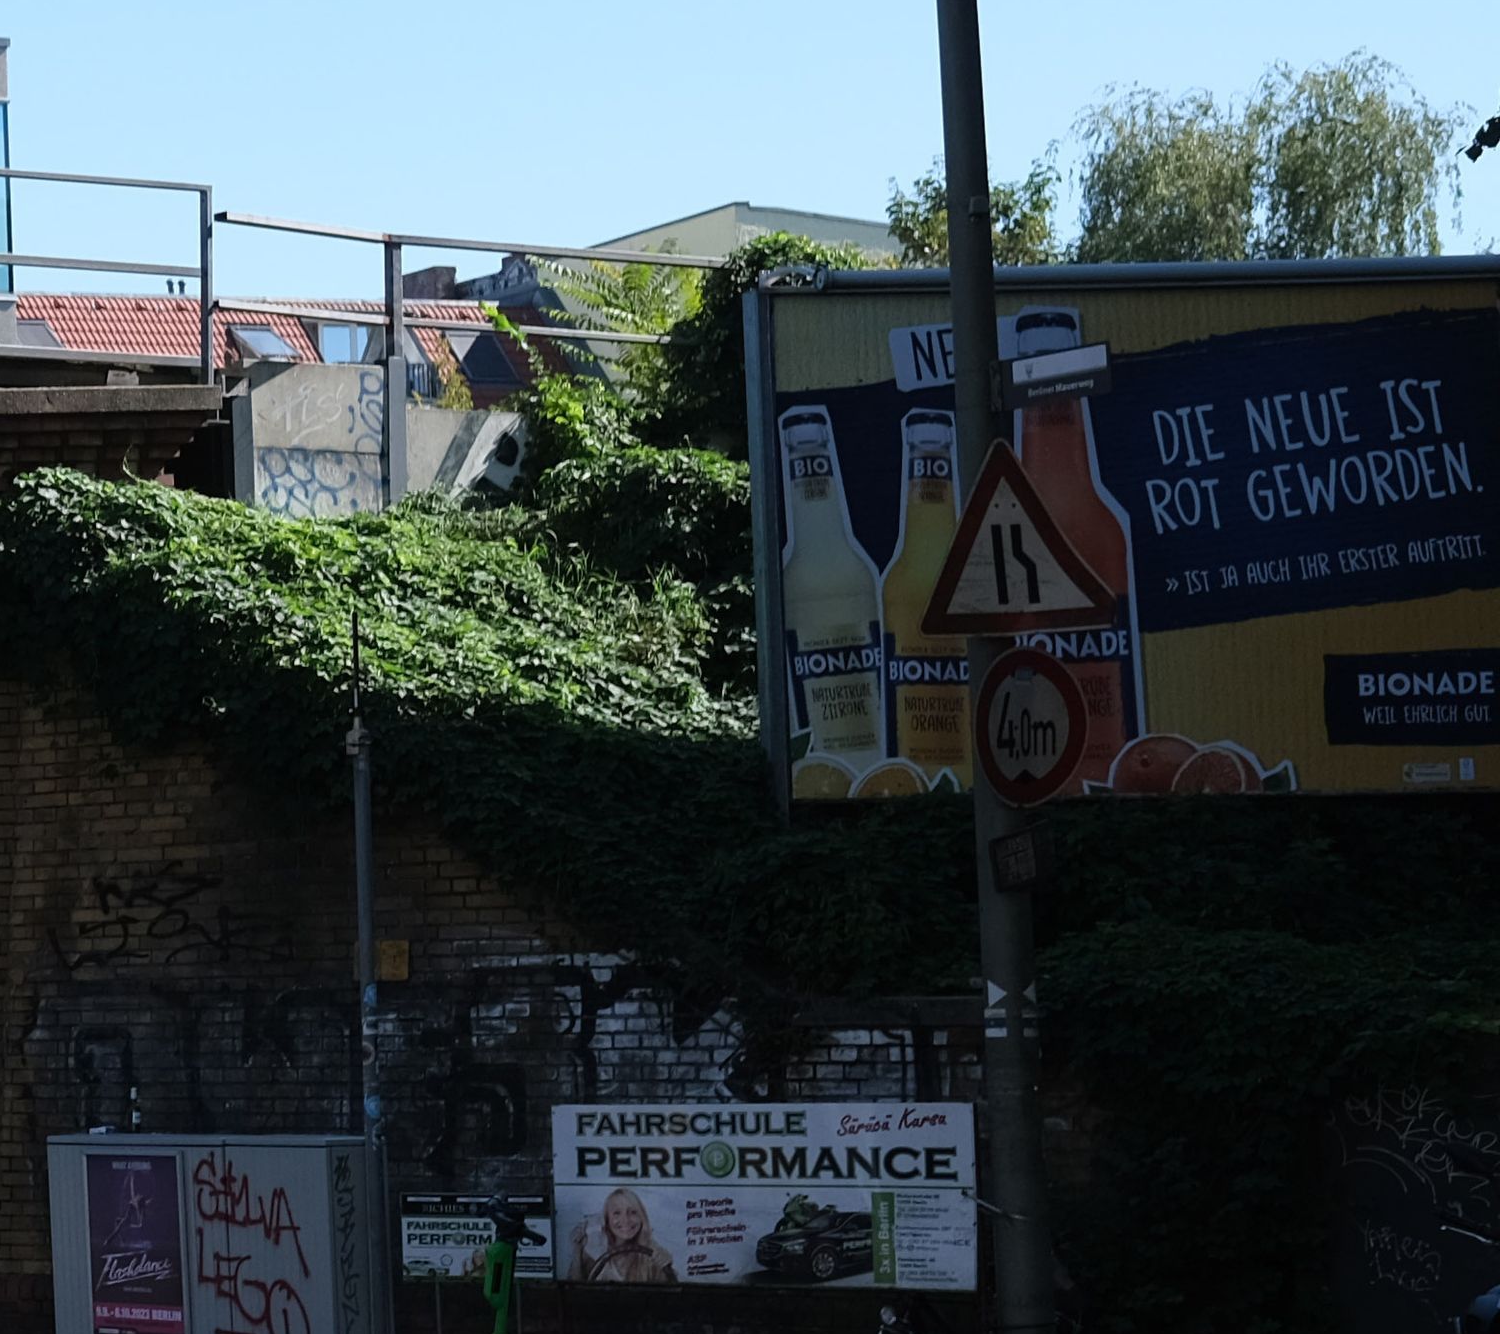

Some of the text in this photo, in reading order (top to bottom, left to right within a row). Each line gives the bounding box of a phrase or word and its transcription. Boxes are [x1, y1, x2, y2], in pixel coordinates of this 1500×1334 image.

[1152, 377, 1444, 468] DIE NEUE IST
[793, 458, 830, 475] BIO
[912, 458, 949, 477] BIO
[1145, 441, 1485, 536] ROT GEWORDEN.
[1184, 533, 1488, 596] IST JA AUCH IHR ERSTER AUFTRITT.
[794, 647, 882, 676] BIONADE
[888, 656, 969, 683] BIONAD
[1357, 669, 1496, 698] BIONADE
[910, 712, 961, 734] ORANGE
[1362, 703, 1398, 726] WEIL
[1403, 703, 1458, 725] EHRLICH
[575, 1110, 807, 1137] FAHRSCHULE
[575, 1141, 959, 1181] PERFORMANCE
[406, 1221, 493, 1231] FAHRSCHULE
[877, 1200, 890, 1240] Berlin
